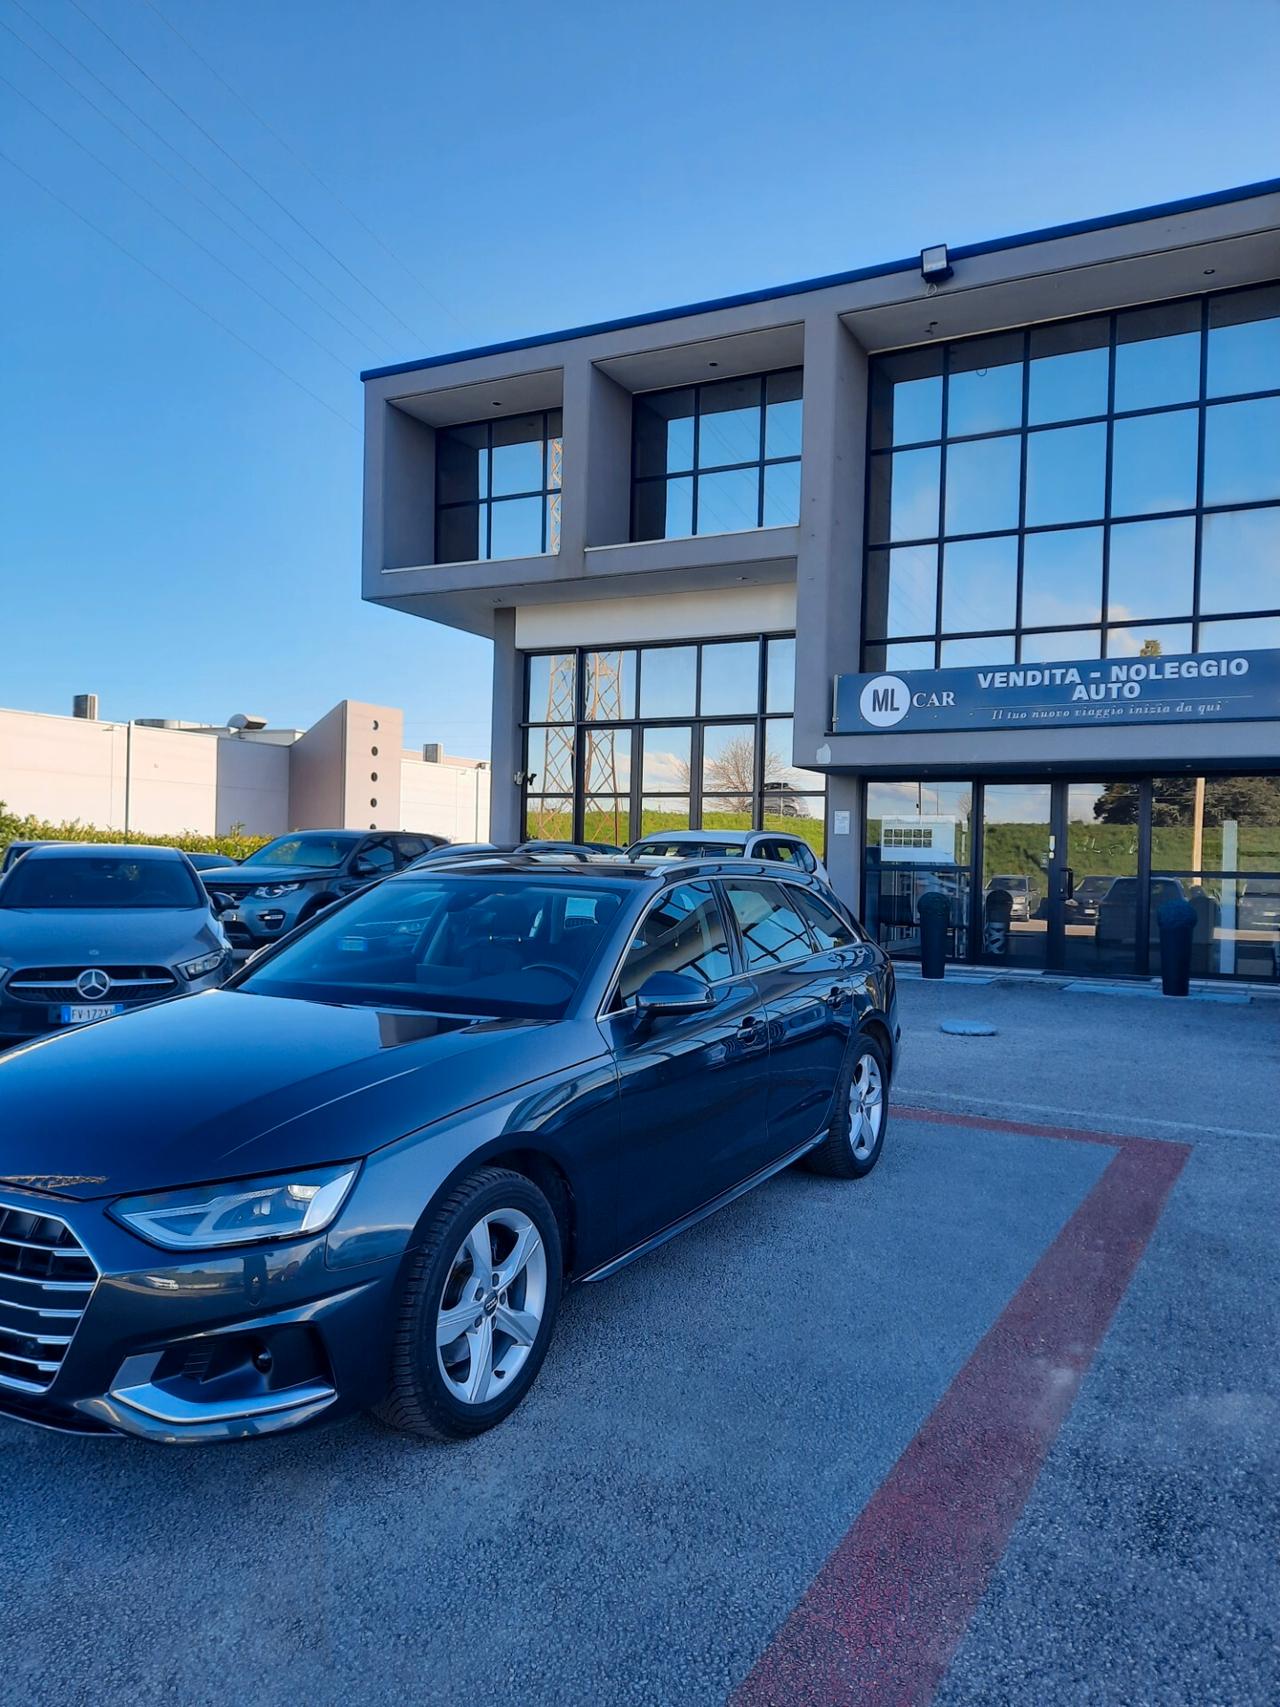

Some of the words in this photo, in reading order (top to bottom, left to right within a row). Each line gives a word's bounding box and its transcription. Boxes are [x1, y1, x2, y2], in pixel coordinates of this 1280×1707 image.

[977, 667, 1082, 689] VENDITA
[1110, 658, 1249, 682] NOLEGGIO
[872, 688, 900, 712] ML
[912, 691, 956, 708] CAR
[1071, 681, 1141, 701] AUTO
[991, 709, 1003, 720] Il
[1007, 711, 1027, 719] tuo
[1032, 709, 1070, 718] nuovo
[1074, 705, 1124, 718] viaggio
[1129, 702, 1170, 714] inizia
[1176, 701, 1193, 713] da
[1198, 700, 1222, 715] qui
[71, 1009, 84, 1019] FV
